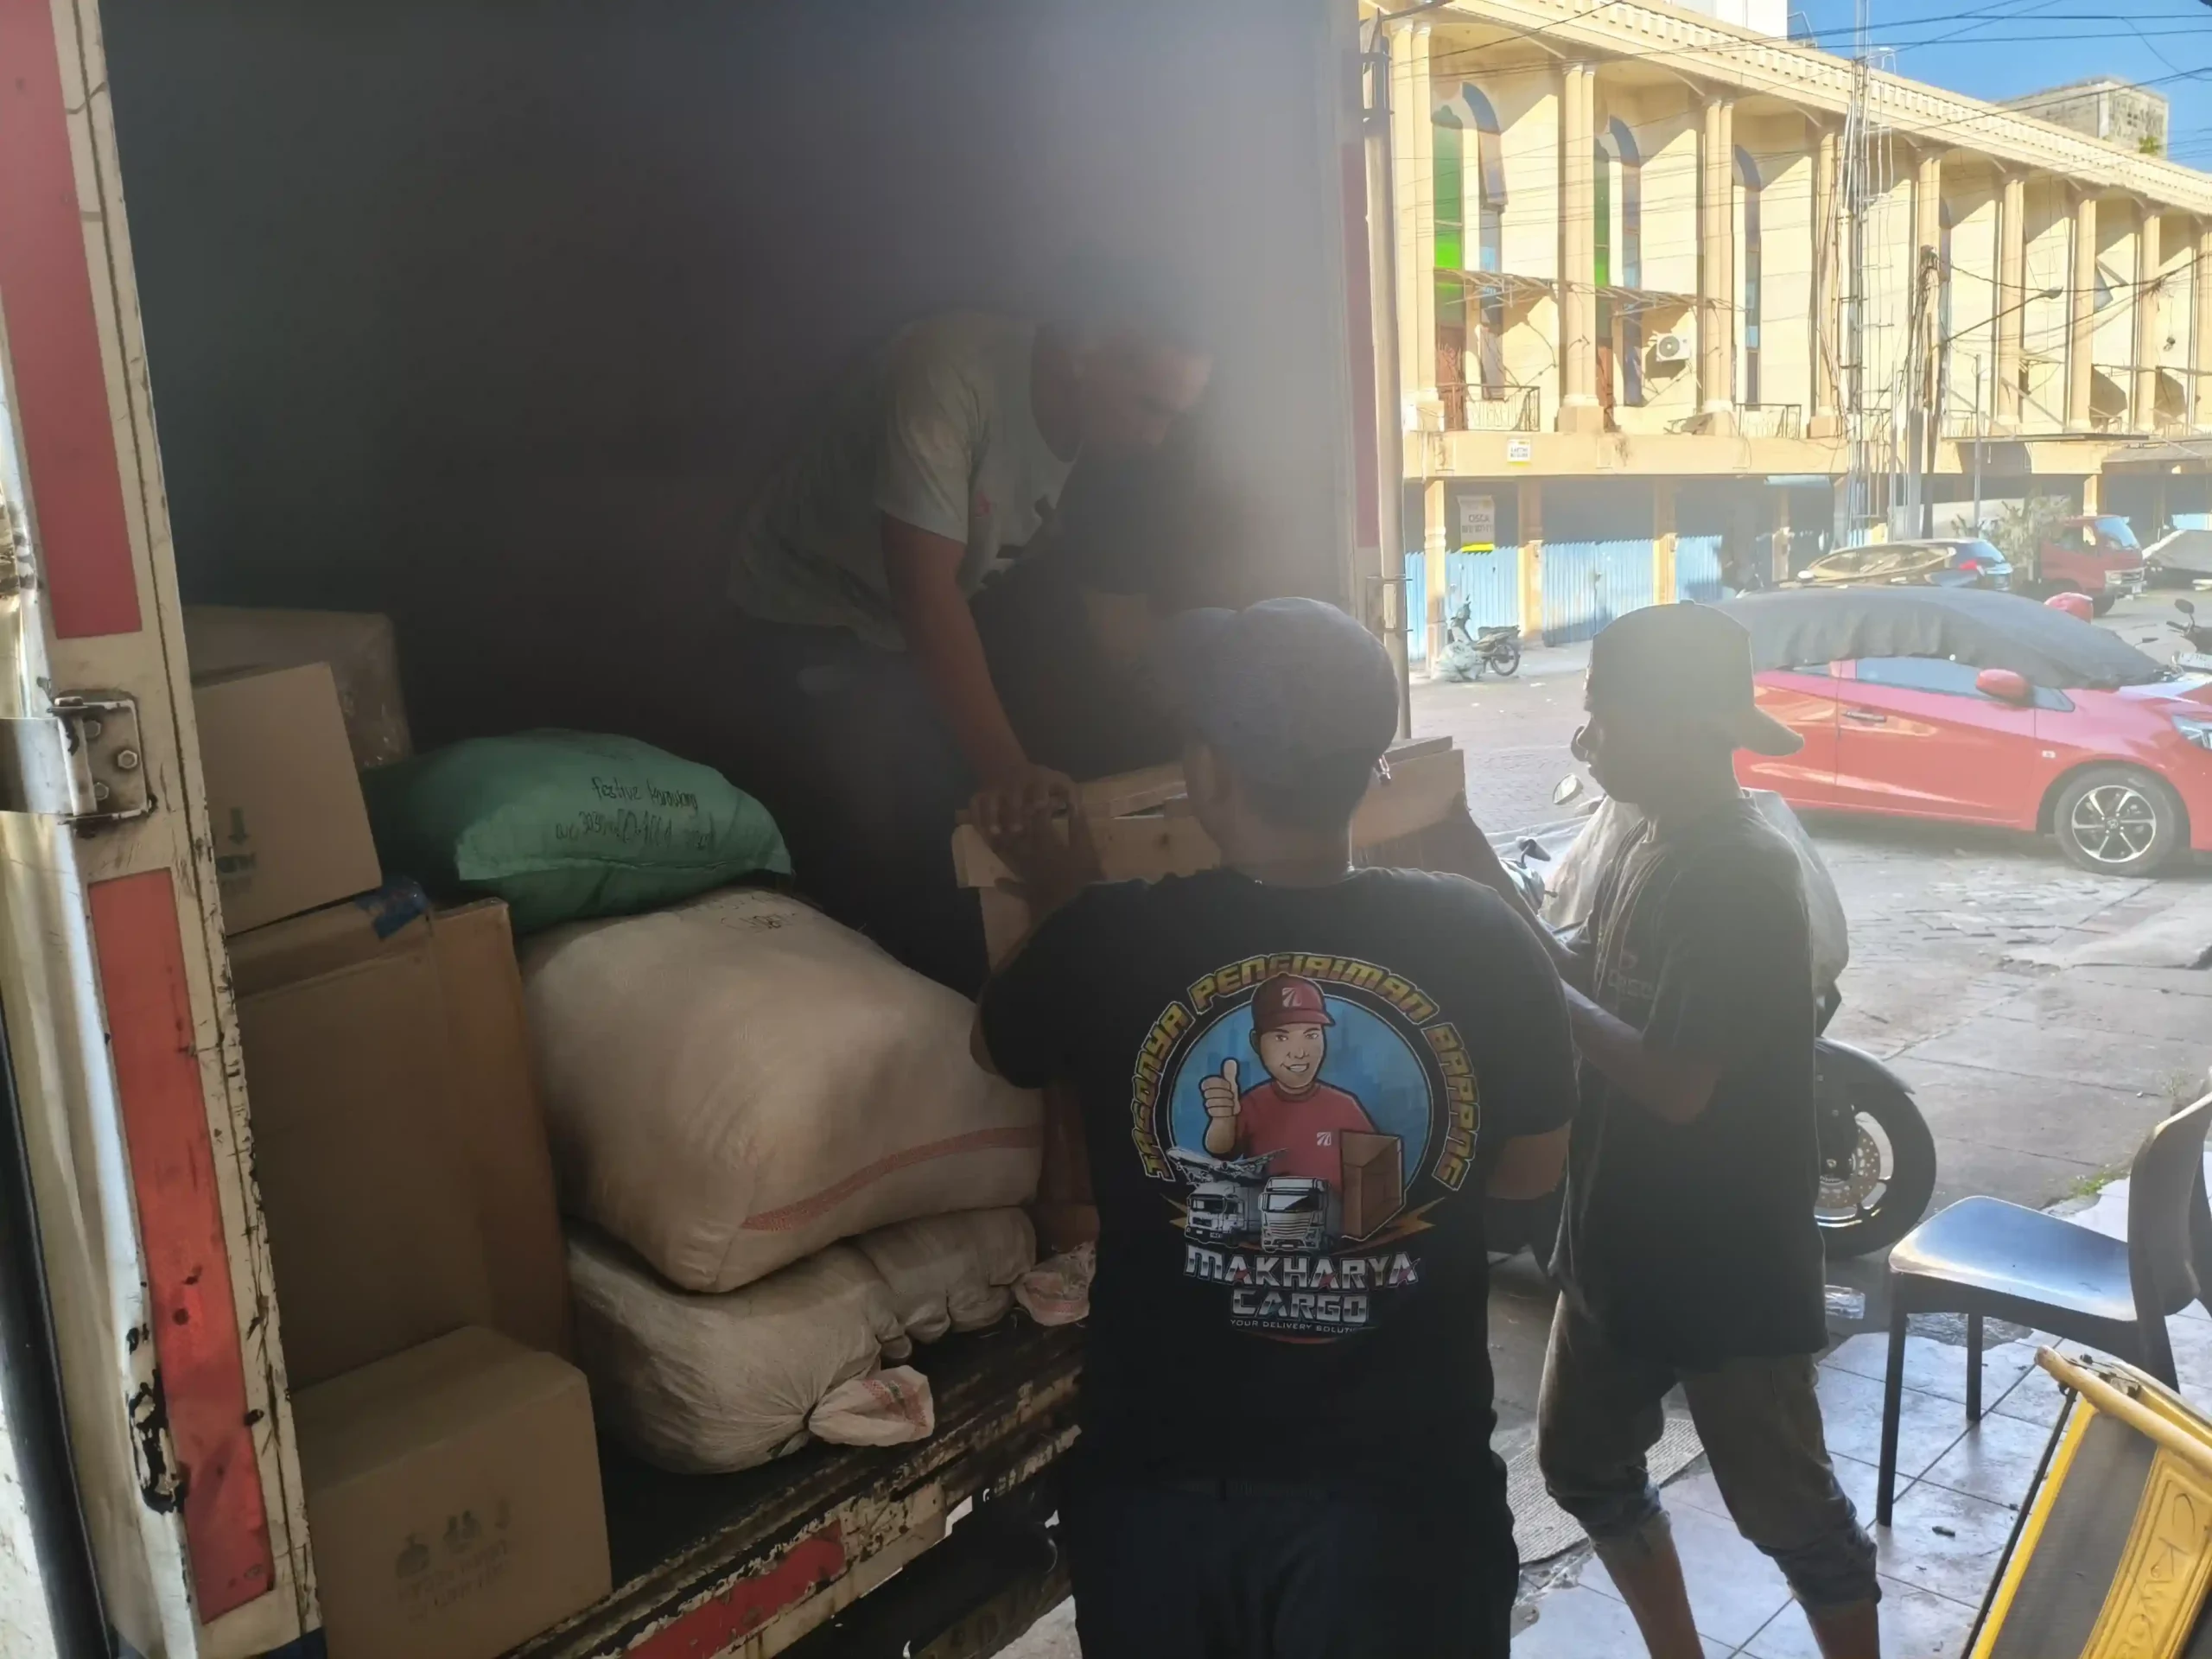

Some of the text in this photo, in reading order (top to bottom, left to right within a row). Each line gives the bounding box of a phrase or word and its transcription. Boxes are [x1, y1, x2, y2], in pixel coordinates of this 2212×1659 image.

[1184, 1244, 1421, 1290] MAKHARYA
[1231, 1290, 1368, 1323] CARGO
[1230, 1319, 1259, 1327] YOUR
[1262, 1321, 1313, 1331] DELIVERY
